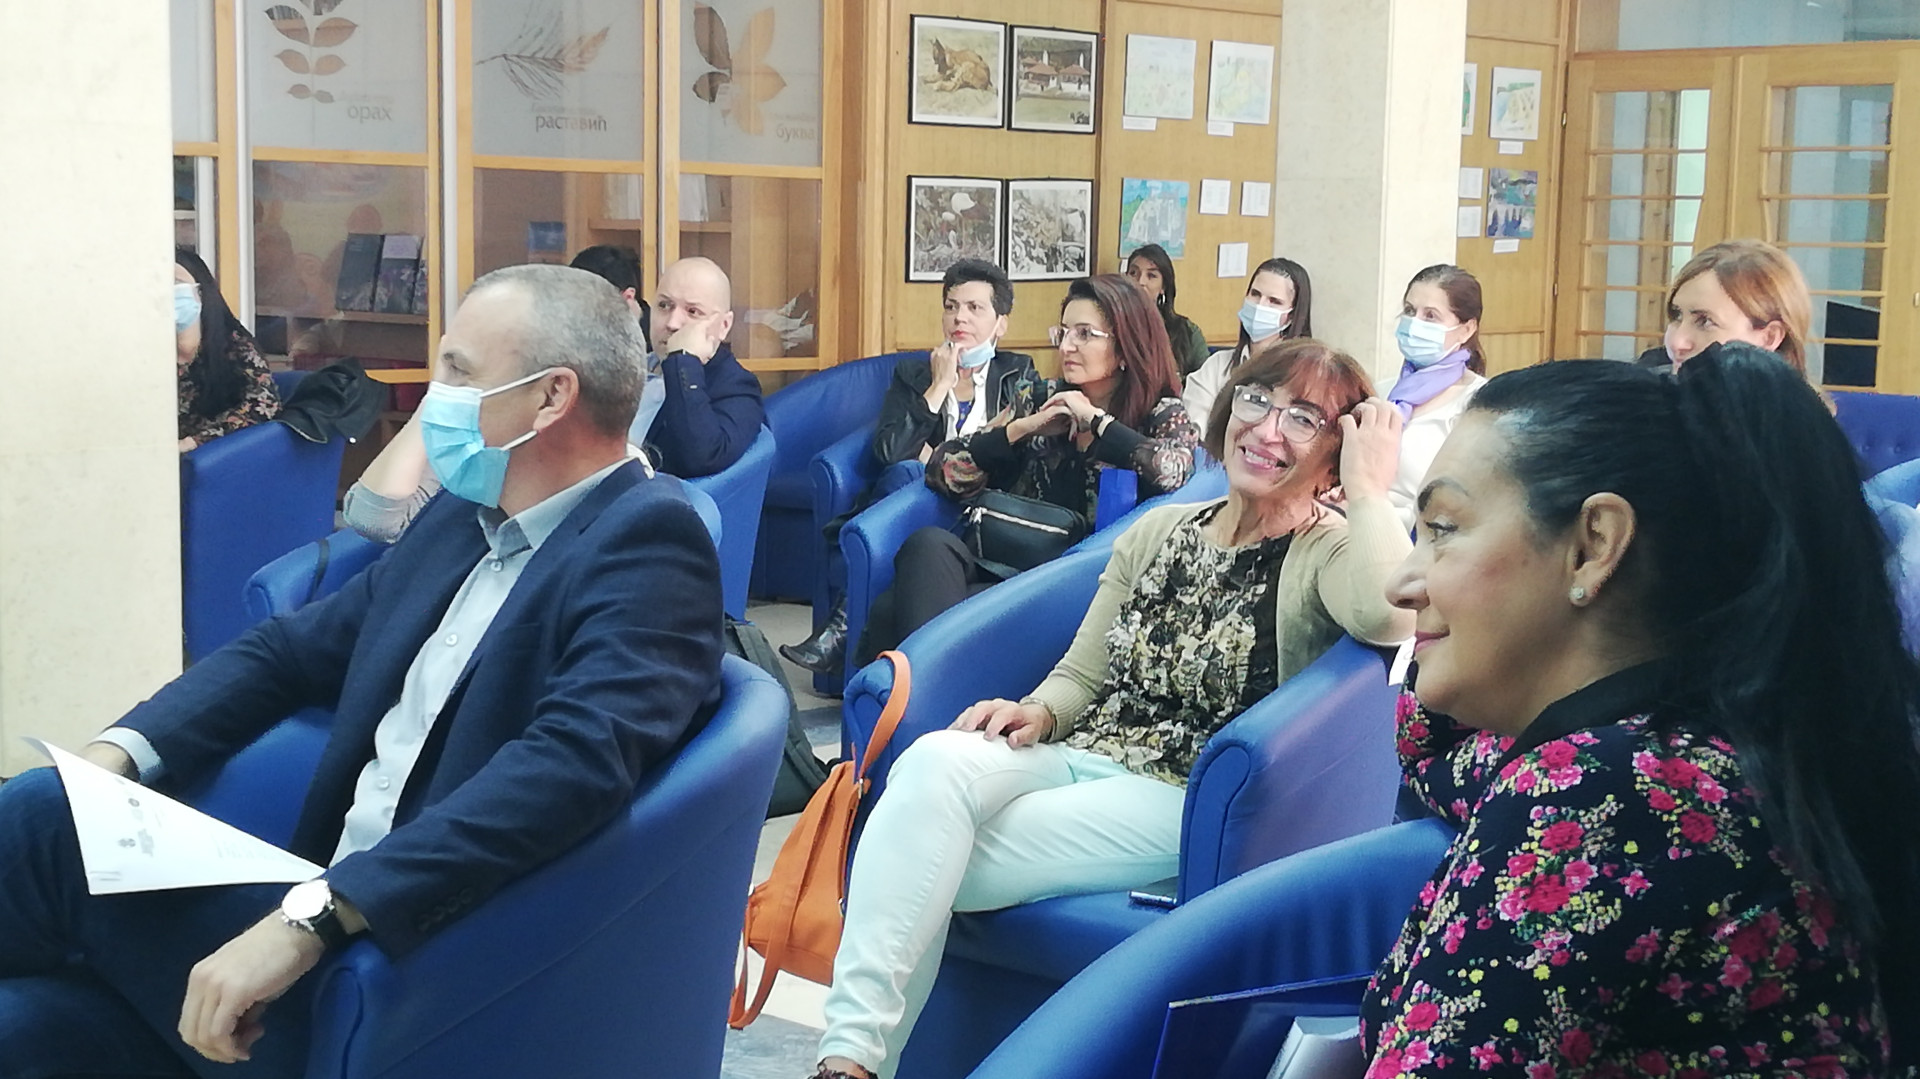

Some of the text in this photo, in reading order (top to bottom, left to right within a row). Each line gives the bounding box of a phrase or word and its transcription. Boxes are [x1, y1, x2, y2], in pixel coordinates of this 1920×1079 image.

[347, 104, 392, 124] орах
[535, 114, 607, 133] раставић
[775, 122, 816, 143] буква
